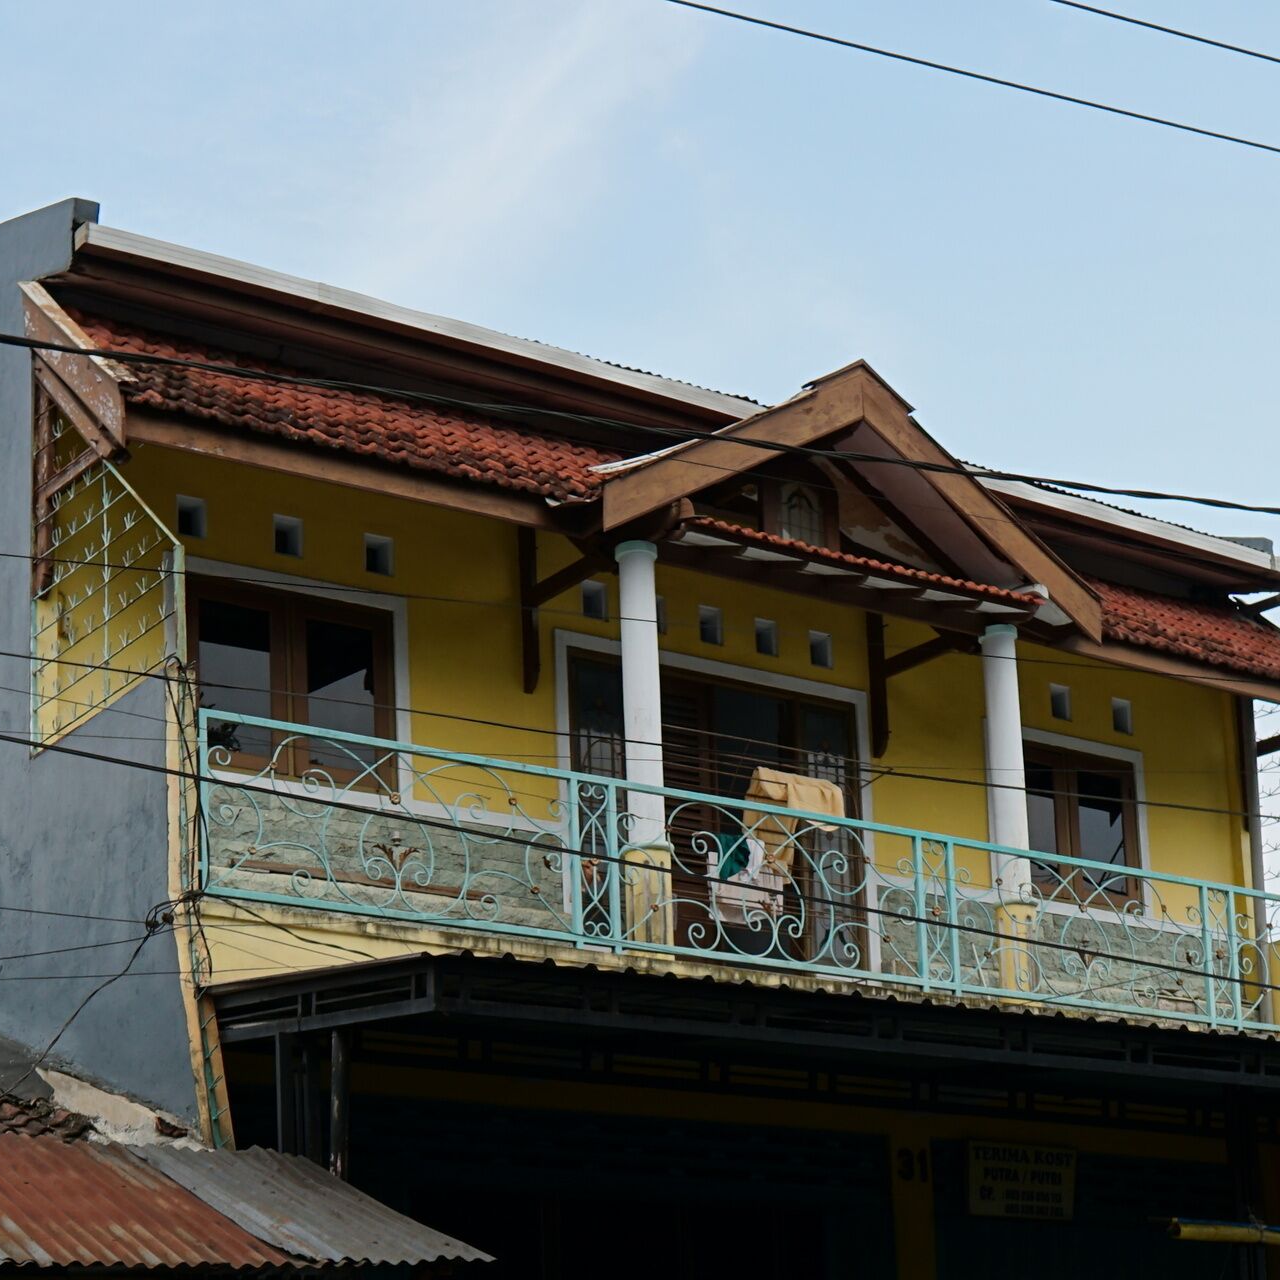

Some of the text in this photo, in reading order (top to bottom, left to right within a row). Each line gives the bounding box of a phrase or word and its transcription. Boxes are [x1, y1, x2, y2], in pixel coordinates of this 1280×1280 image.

[897, 1148, 929, 1182] 31
[972, 1146, 1073, 1167] TERIMA KOST
[983, 1167, 1020, 1182] PUTRA
[1030, 1170, 1062, 1185] PUTRI
